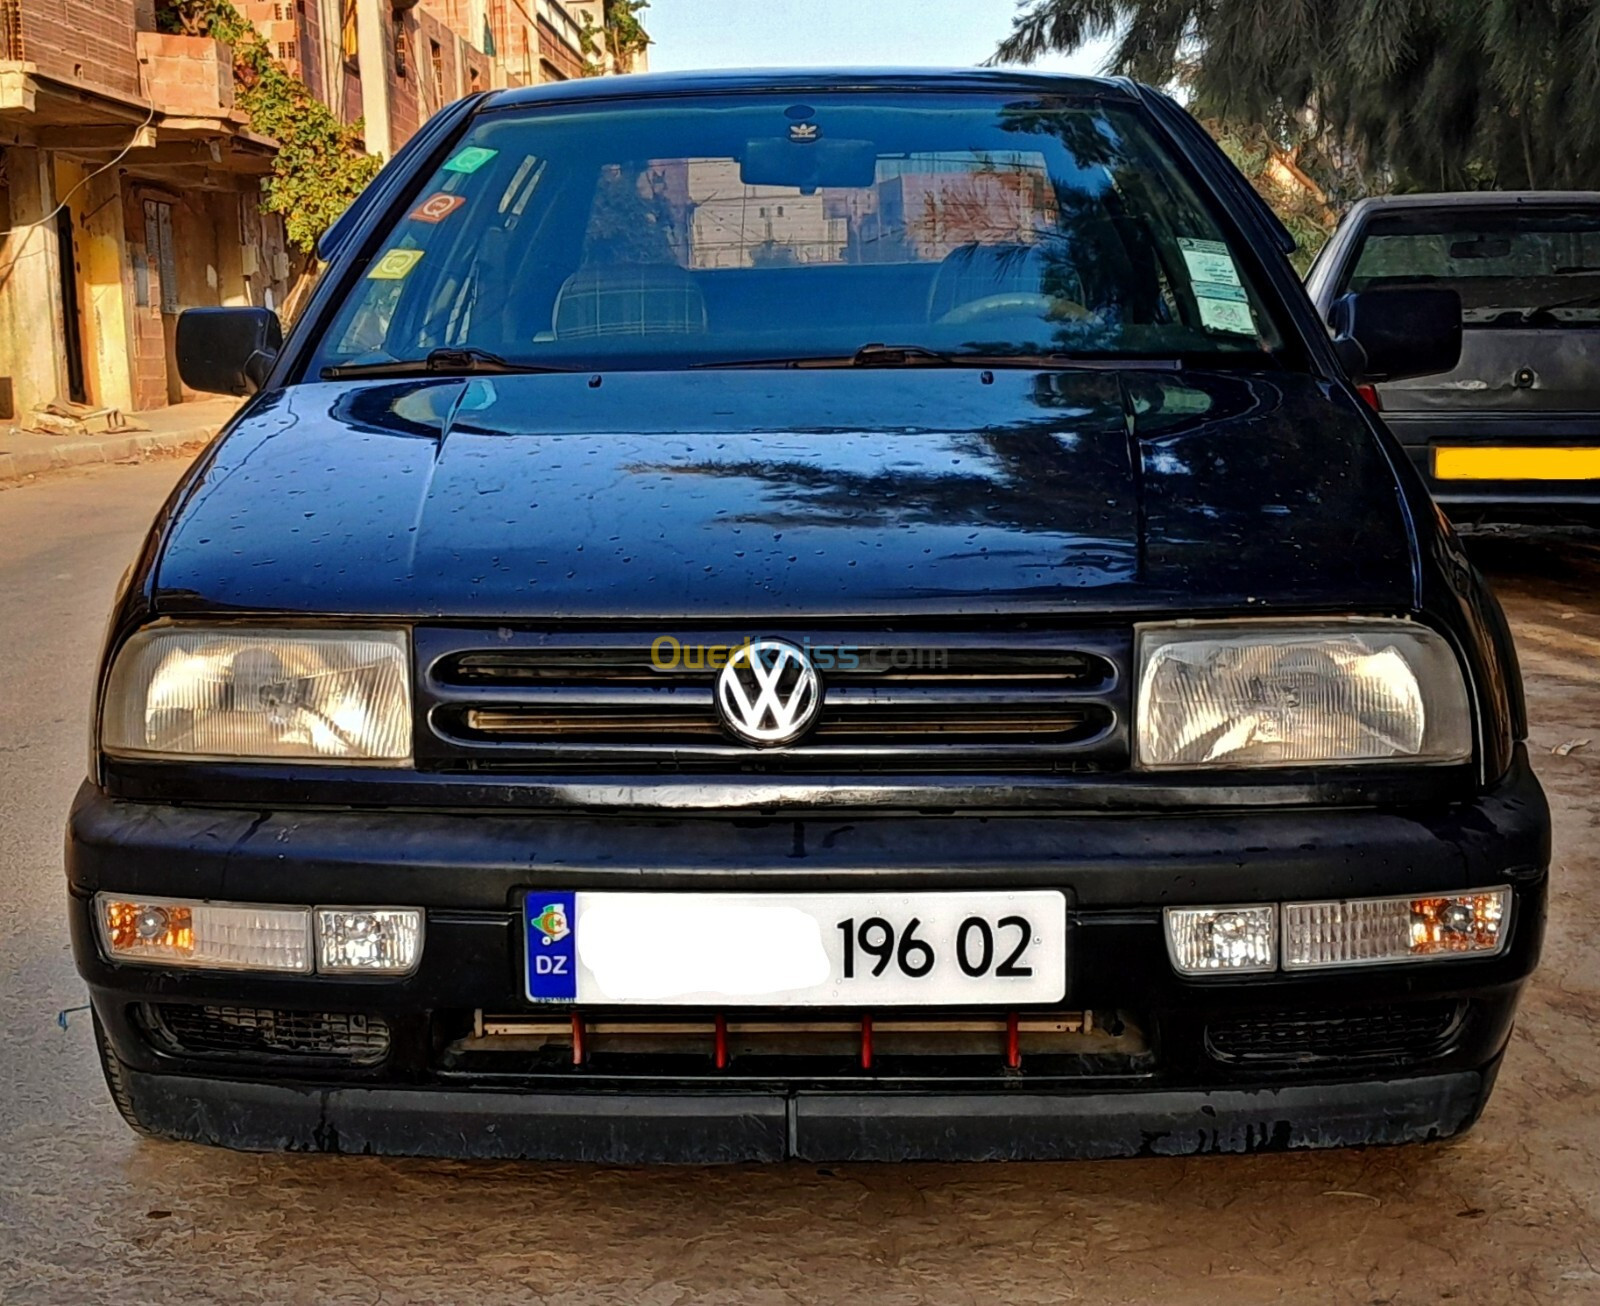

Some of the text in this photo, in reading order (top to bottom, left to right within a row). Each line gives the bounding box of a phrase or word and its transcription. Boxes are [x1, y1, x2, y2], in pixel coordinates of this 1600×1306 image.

[535, 955, 568, 975] DZ
[837, 915, 1033, 979] 196 02
